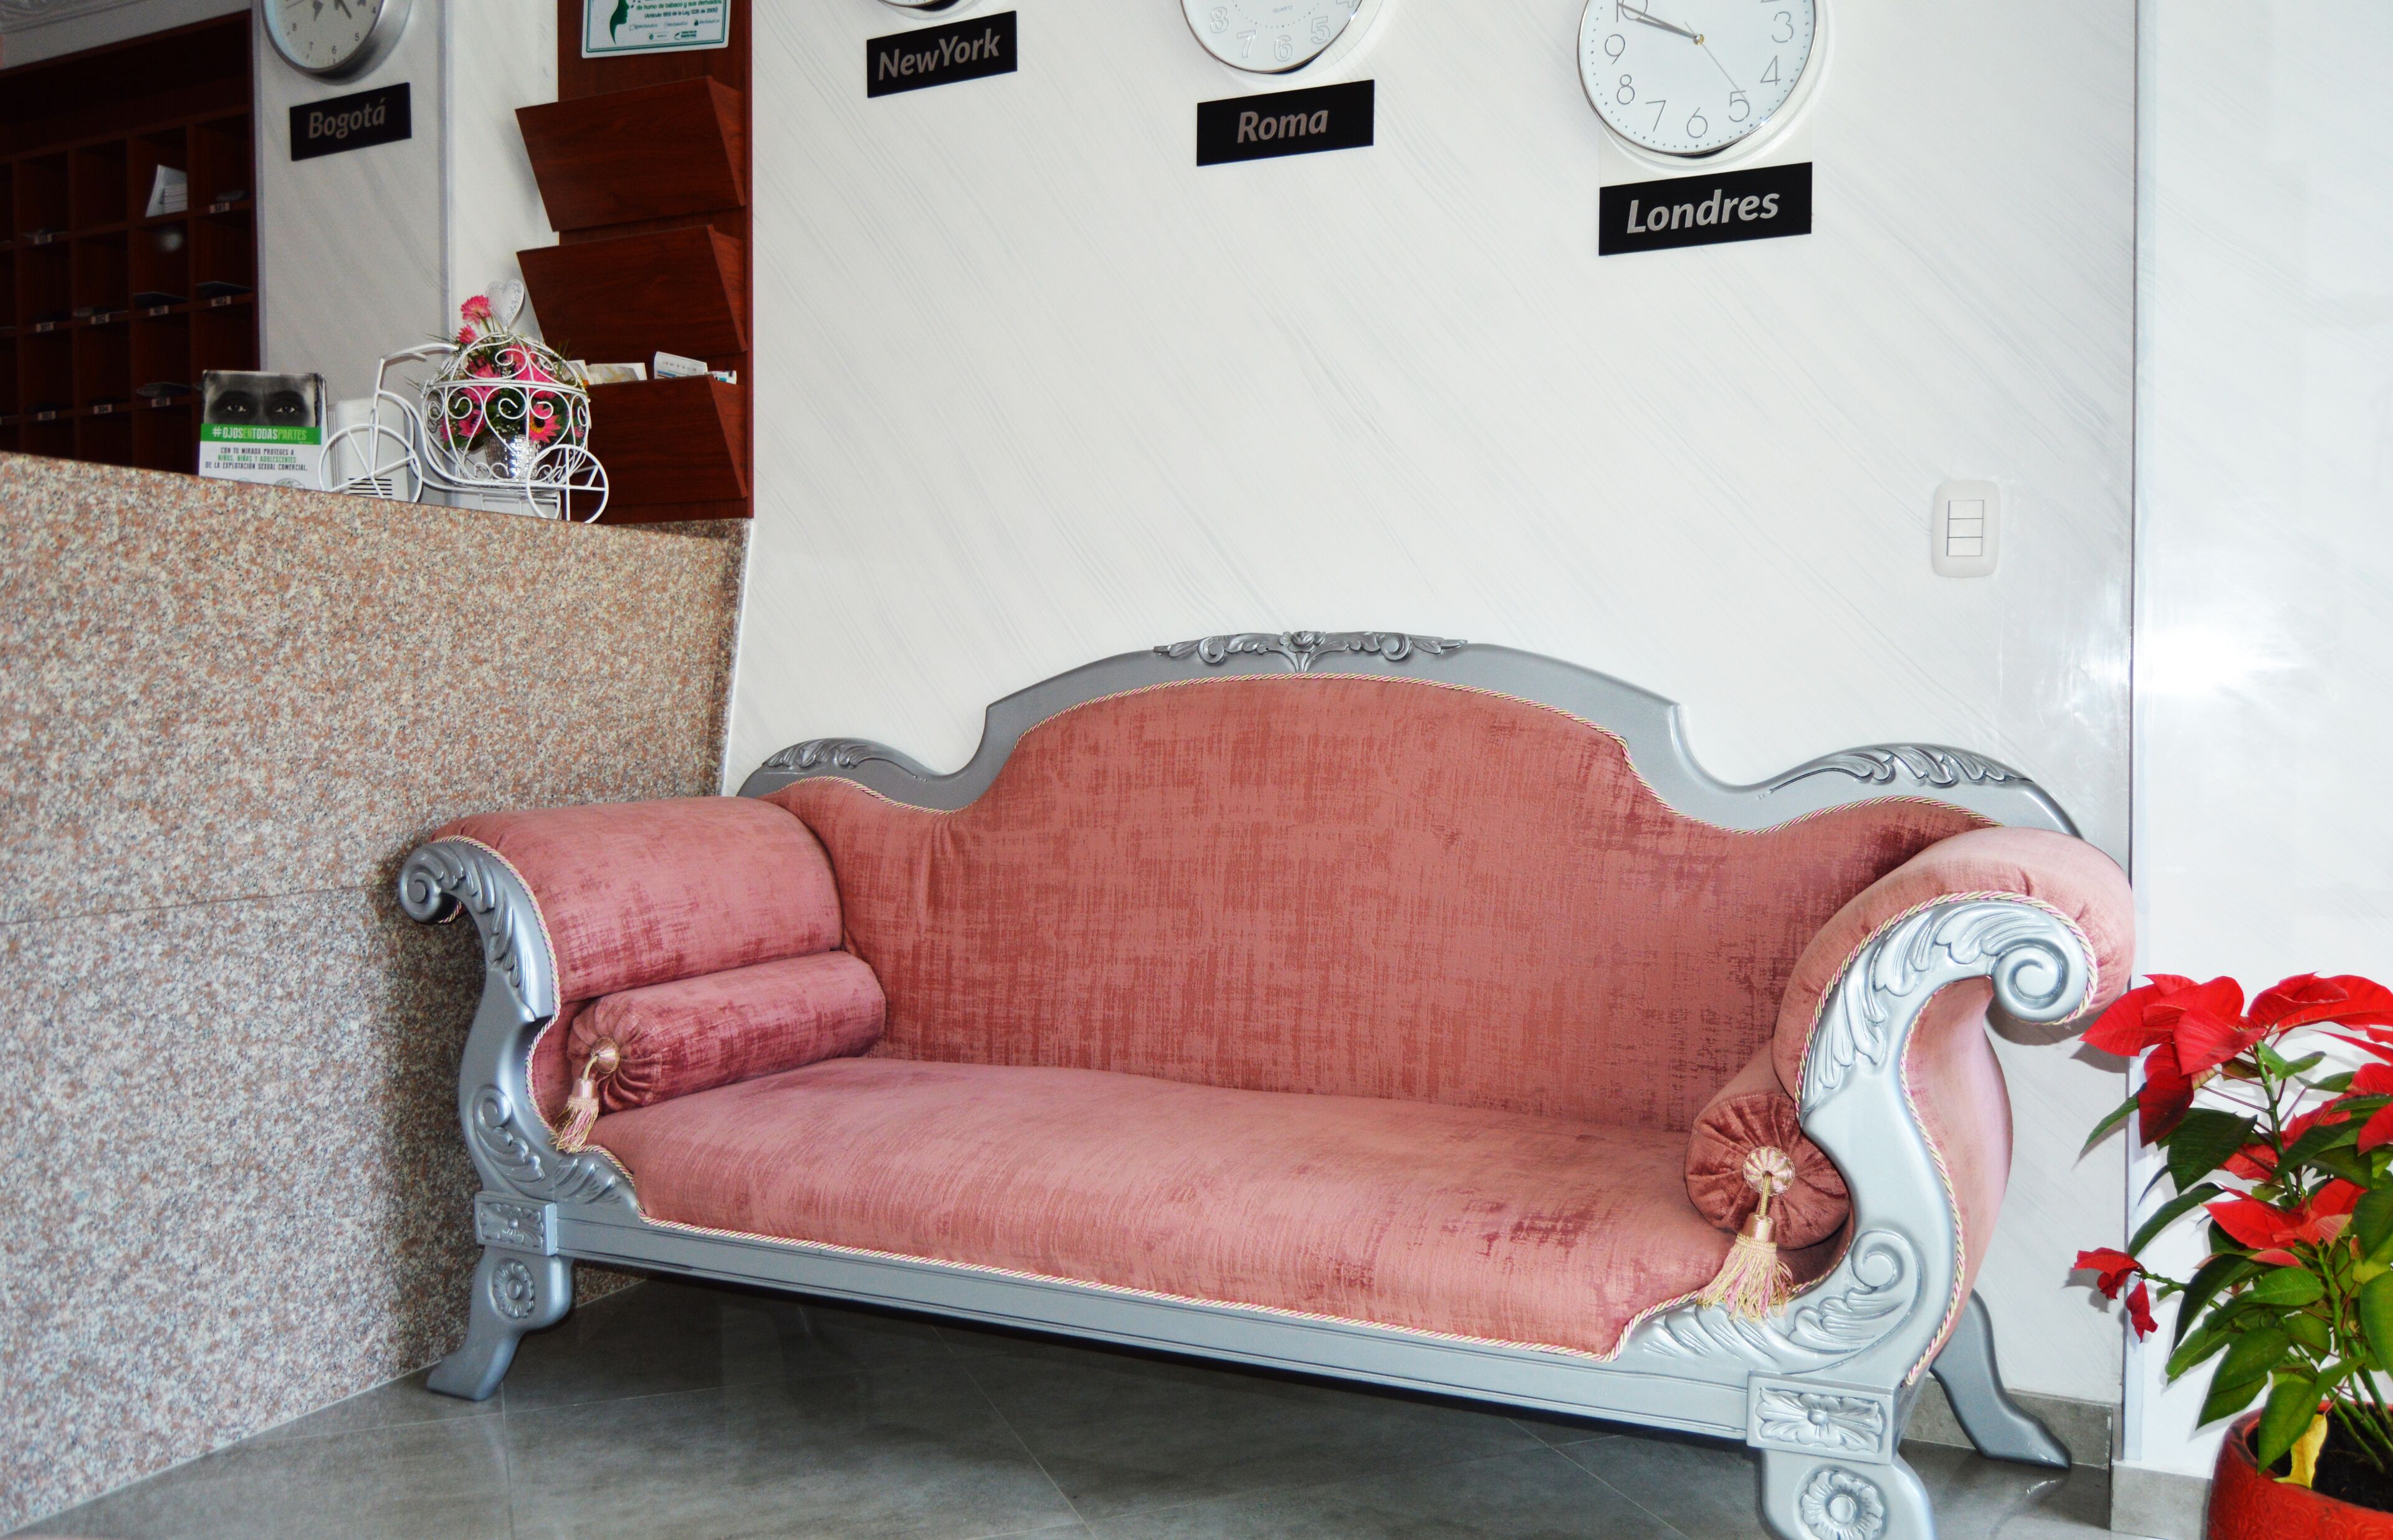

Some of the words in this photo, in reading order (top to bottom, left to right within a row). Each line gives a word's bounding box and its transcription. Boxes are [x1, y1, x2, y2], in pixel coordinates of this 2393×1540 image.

[1210, 7, 1230, 34] 8
[1311, 16, 1330, 44] 5
[1772, 11, 1794, 43] 3
[332, 45, 337, 54] 6
[1237, 30, 1256, 59] 7
[1274, 35, 1293, 62] 6
[1605, 34, 1625, 65] 9
[1760, 55, 1781, 86] 4
[1617, 74, 1635, 105] 8
[308, 97, 386, 139] Bogotá
[1645, 100, 1666, 132] 7
[1729, 90, 1750, 122] 5
[1237, 110, 1329, 143] Roma
[1686, 107, 1708, 138] 6
[1626, 189, 1780, 234] Londres
